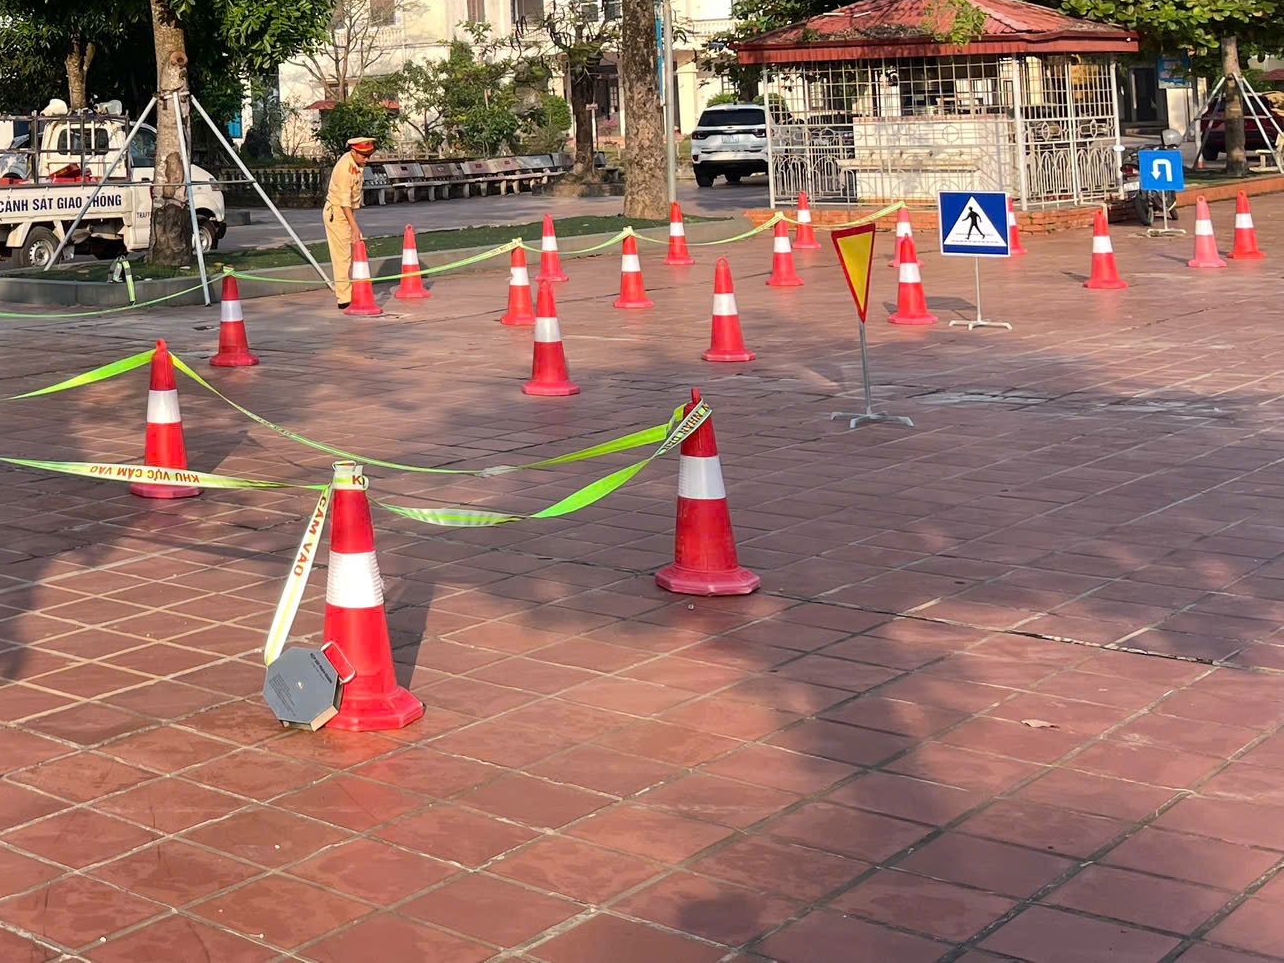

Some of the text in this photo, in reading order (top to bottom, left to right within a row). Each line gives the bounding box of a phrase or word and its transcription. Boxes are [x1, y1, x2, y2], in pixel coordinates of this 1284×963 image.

[32, 195, 54, 210] SÁT
[57, 196, 82, 209] GIAO
[90, 465, 200, 483] KHU VỰC CẤM VÀO
